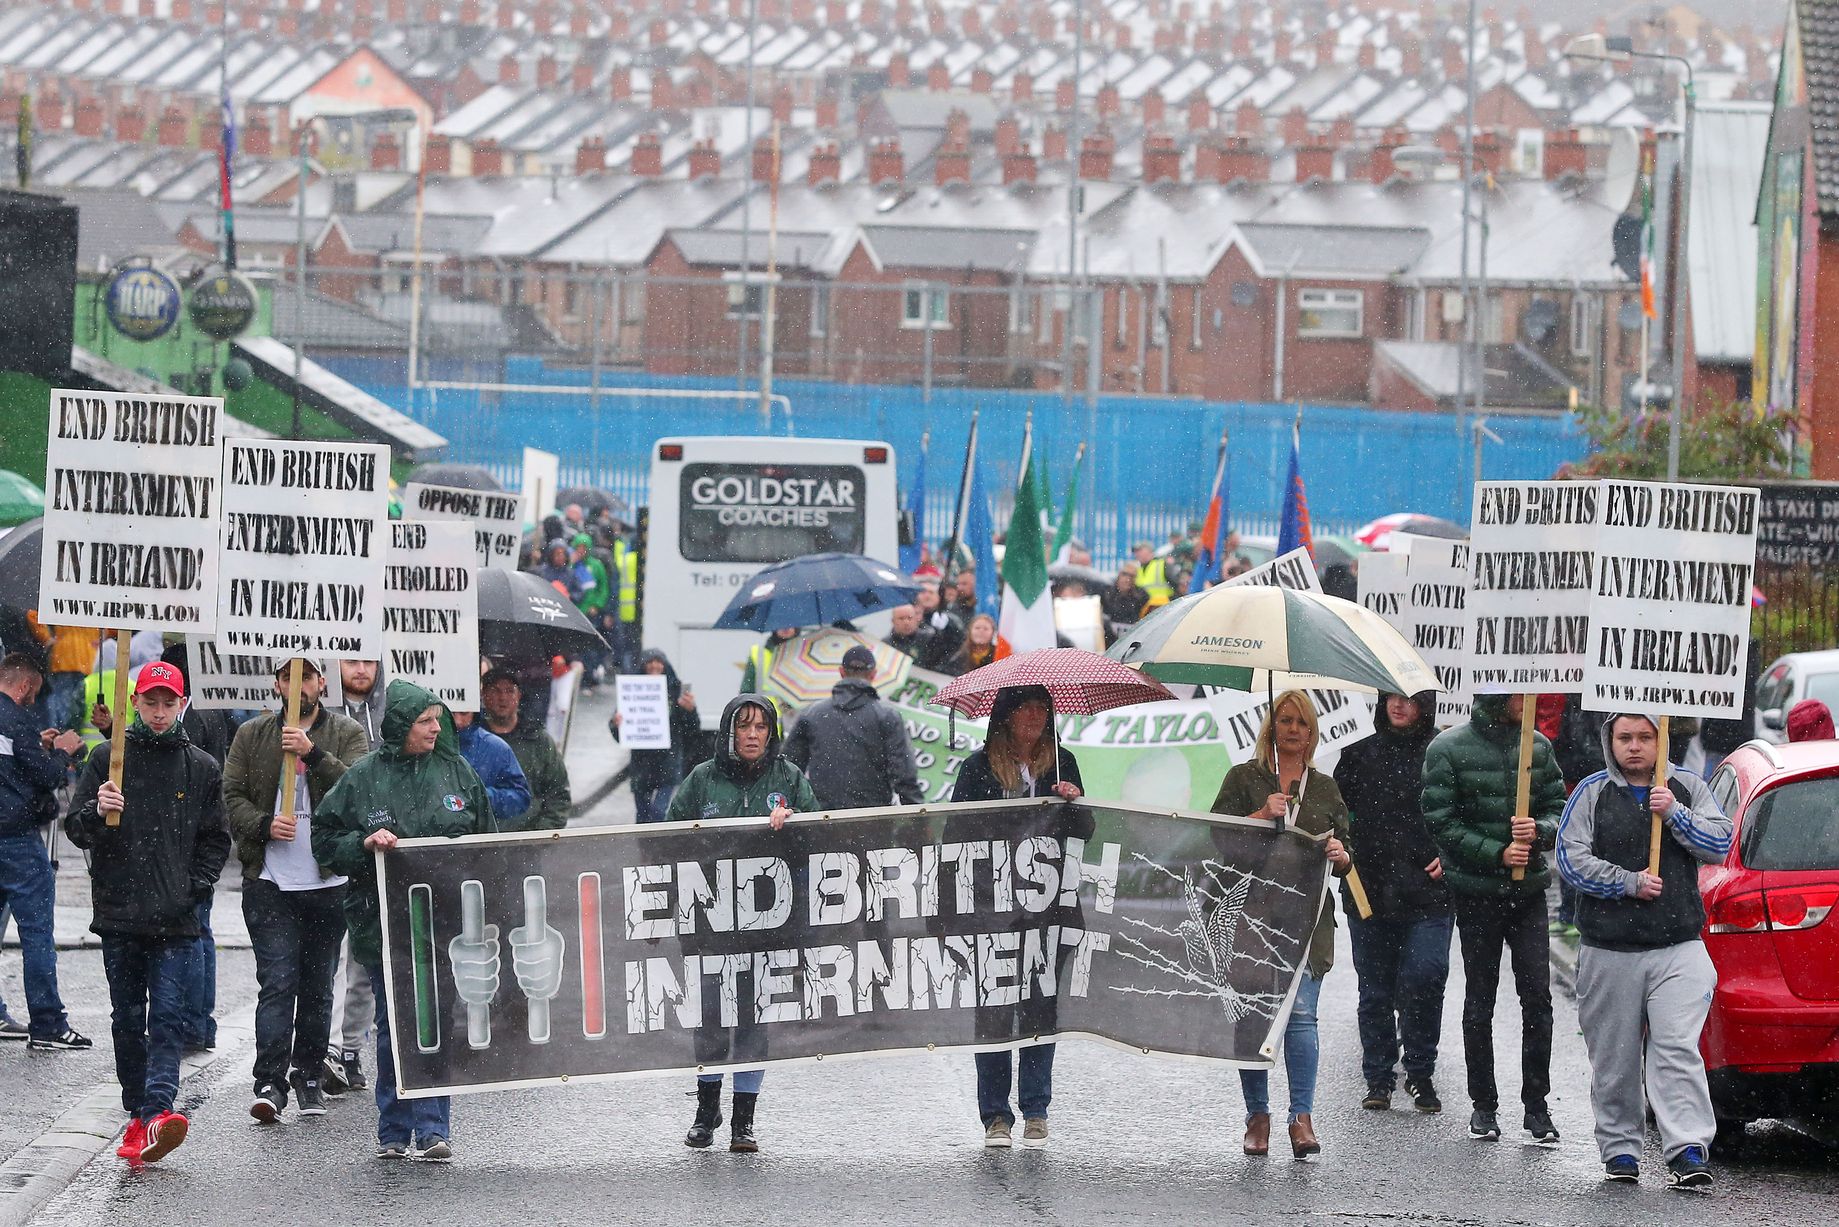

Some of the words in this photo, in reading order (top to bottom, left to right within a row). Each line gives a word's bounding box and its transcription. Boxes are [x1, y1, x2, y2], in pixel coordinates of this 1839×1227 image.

[58, 397, 107, 440] END
[114, 400, 217, 446] BRITISH
[231, 446, 276, 486] END
[281, 449, 376, 492] BRITISH
[53, 468, 214, 518] INTERNMENT
[418, 488, 482, 516] OPPOSE
[485, 496, 517, 520] THE
[692, 476, 855, 506] GOLDSTAR
[1479, 488, 1520, 524] END
[1526, 486, 1600, 525] BRITIS
[718, 508, 829, 526] COACHES
[1605, 485, 1653, 527] END
[1658, 488, 1756, 534] BRITISH
[1778, 502, 1814, 518] TAXI
[226, 512, 374, 558] INTERNMENT
[392, 524, 427, 550] END
[495, 533, 516, 556] OF
[55, 540, 84, 583] IN
[89, 543, 204, 591] IRELAND!
[692, 572, 722, 586] Tel:
[1598, 556, 1750, 606] INTERNMENT
[53, 598, 200, 622] WWW.IRPWA.COM
[230, 578, 254, 617] IN
[261, 580, 364, 623] IRELAND!
[1364, 592, 1405, 615] CON
[228, 632, 362, 652] WWW.IRPWA.COM
[1191, 636, 1262, 649] JAMESON
[1475, 616, 1498, 654] IN
[199, 642, 222, 674] IN
[391, 649, 435, 676] NOW!
[1598, 628, 1626, 668] IN
[1630, 629, 1739, 676] IRELAND!
[152, 666, 172, 680] NY
[1434, 666, 1462, 690] NO
[1596, 684, 1734, 708] WWW.IRPWA.COM
[904, 720, 940, 743] NO
[914, 748, 934, 768] O
[622, 856, 793, 940] END
[808, 836, 1121, 926] BRITISH
[625, 925, 1110, 1034] INTERNMENT
